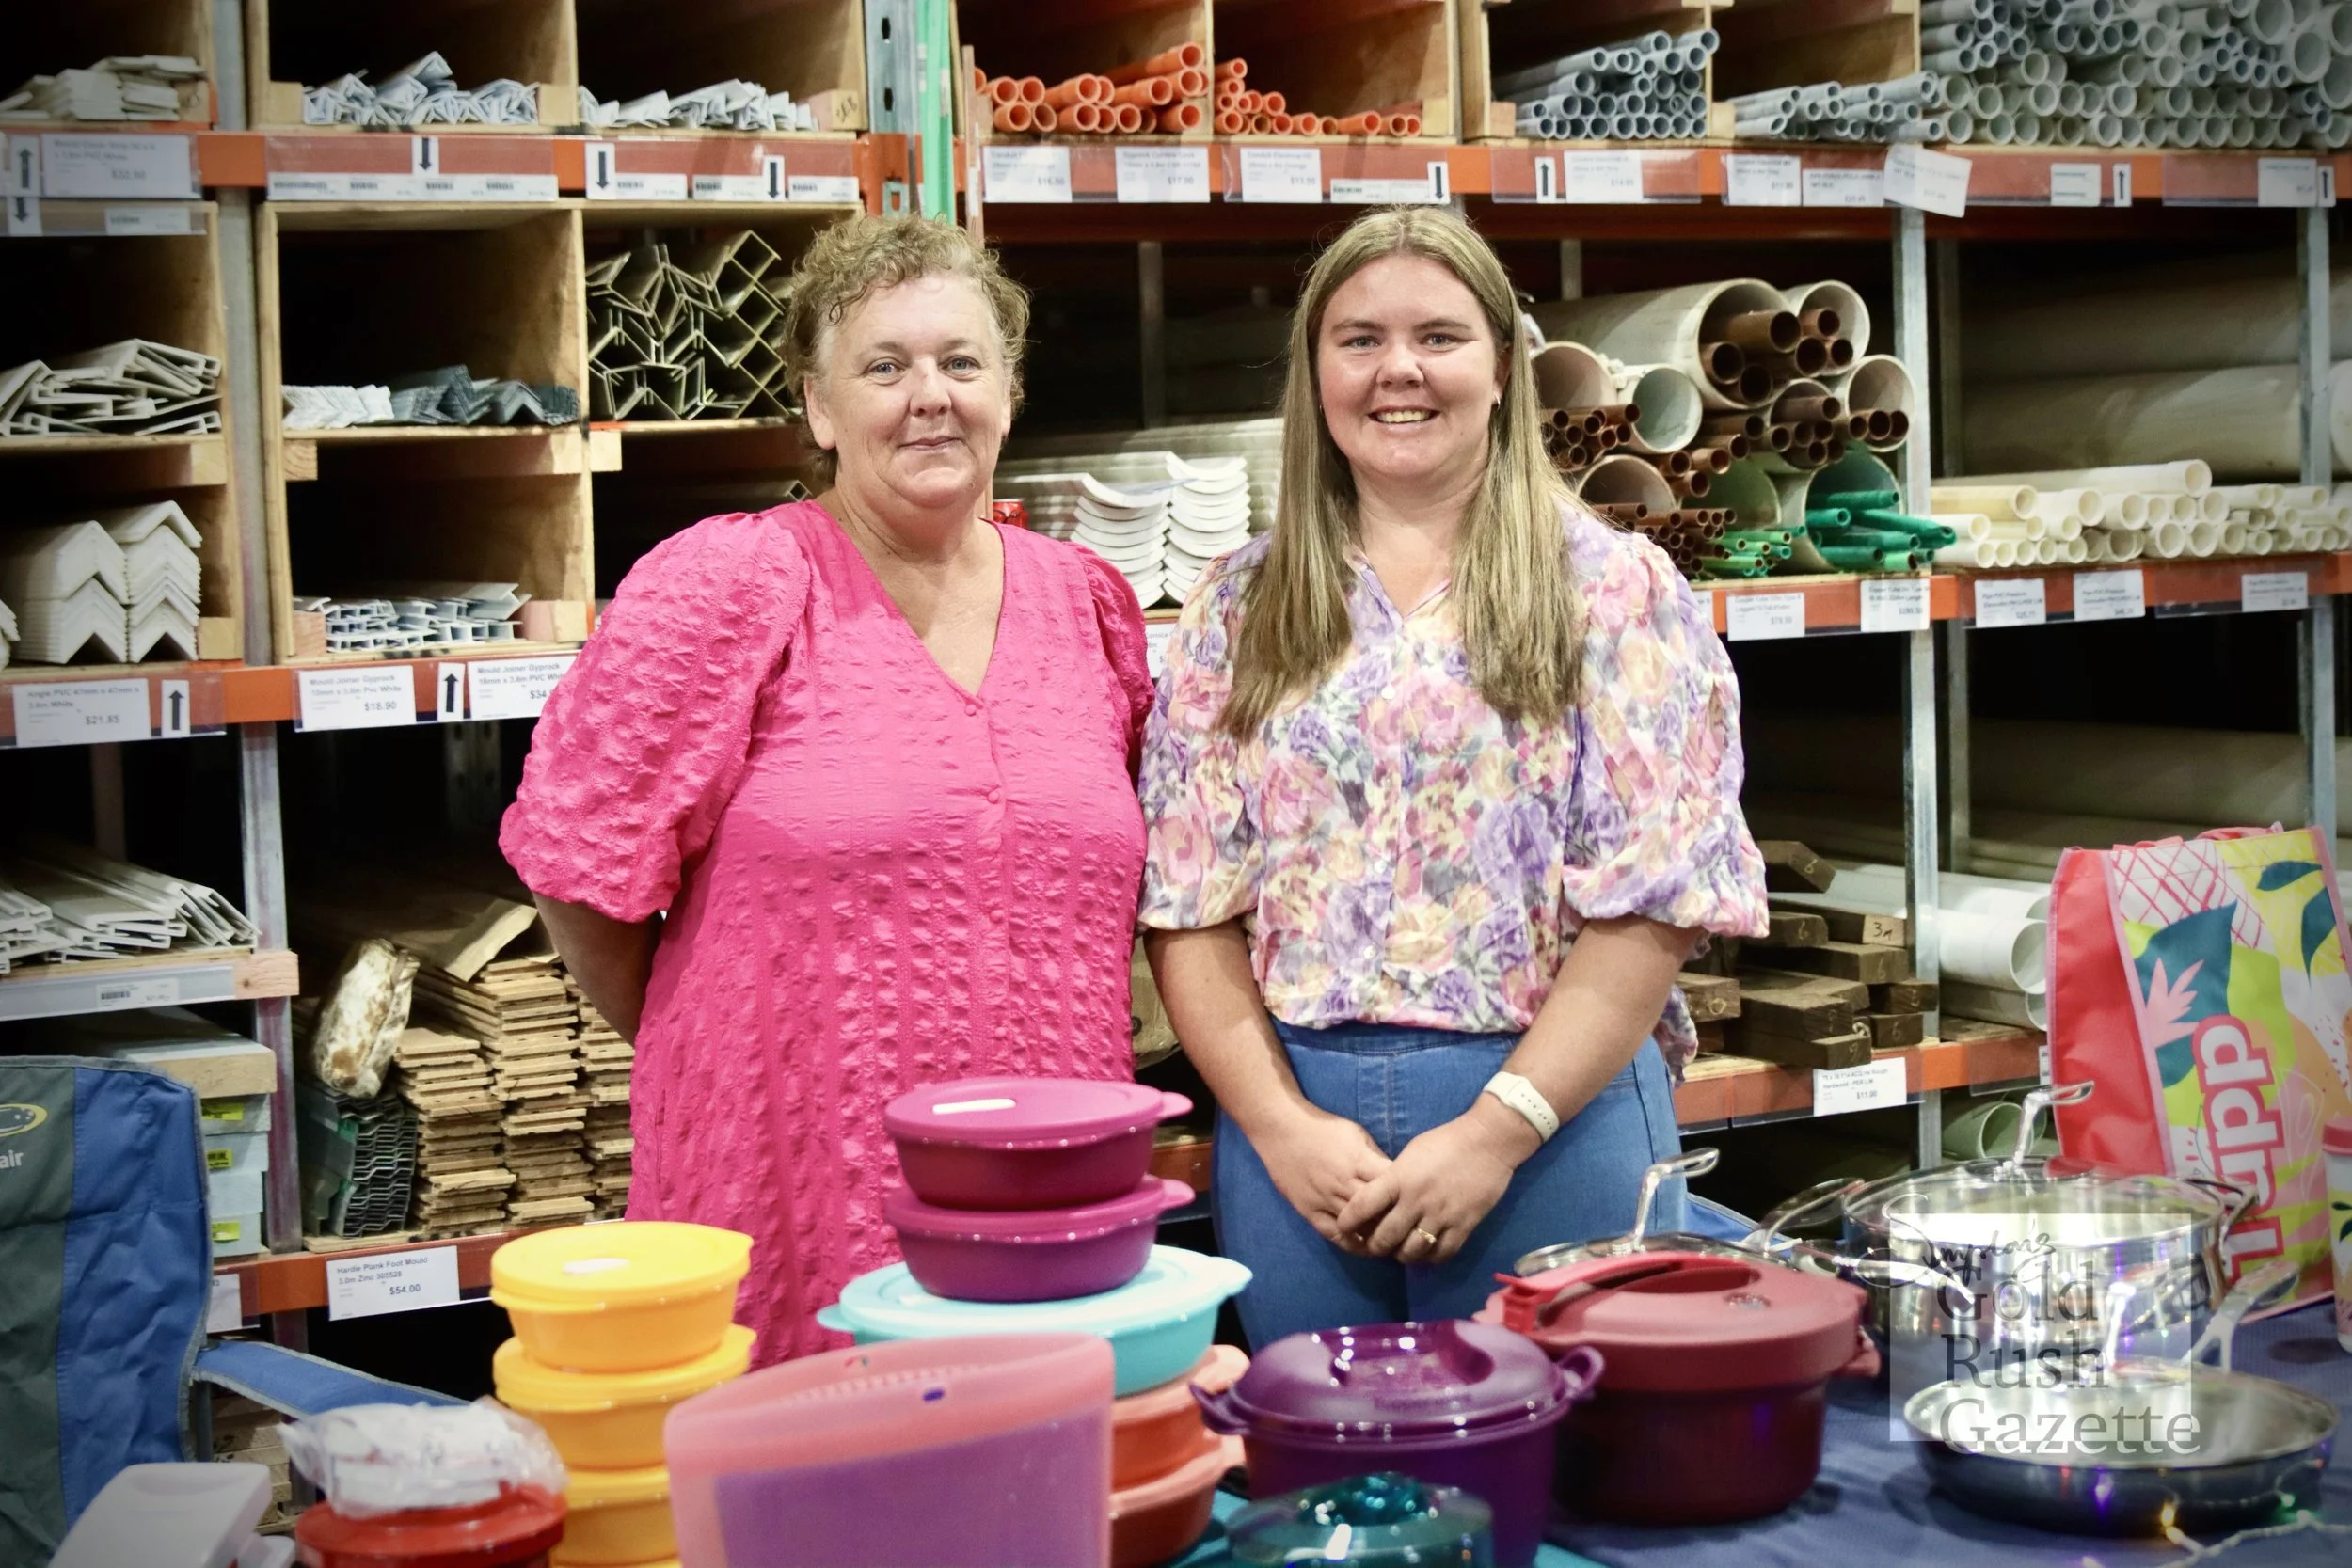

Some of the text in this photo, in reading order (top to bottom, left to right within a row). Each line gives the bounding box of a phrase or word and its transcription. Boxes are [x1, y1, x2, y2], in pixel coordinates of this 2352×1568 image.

[1877, 958, 1887, 979] 6
[337, 1257, 428, 1275] Hardie Plank Foot Mould
[358, 1274, 374, 1283] Zinc
[389, 1283, 421, 1295] $54.00
